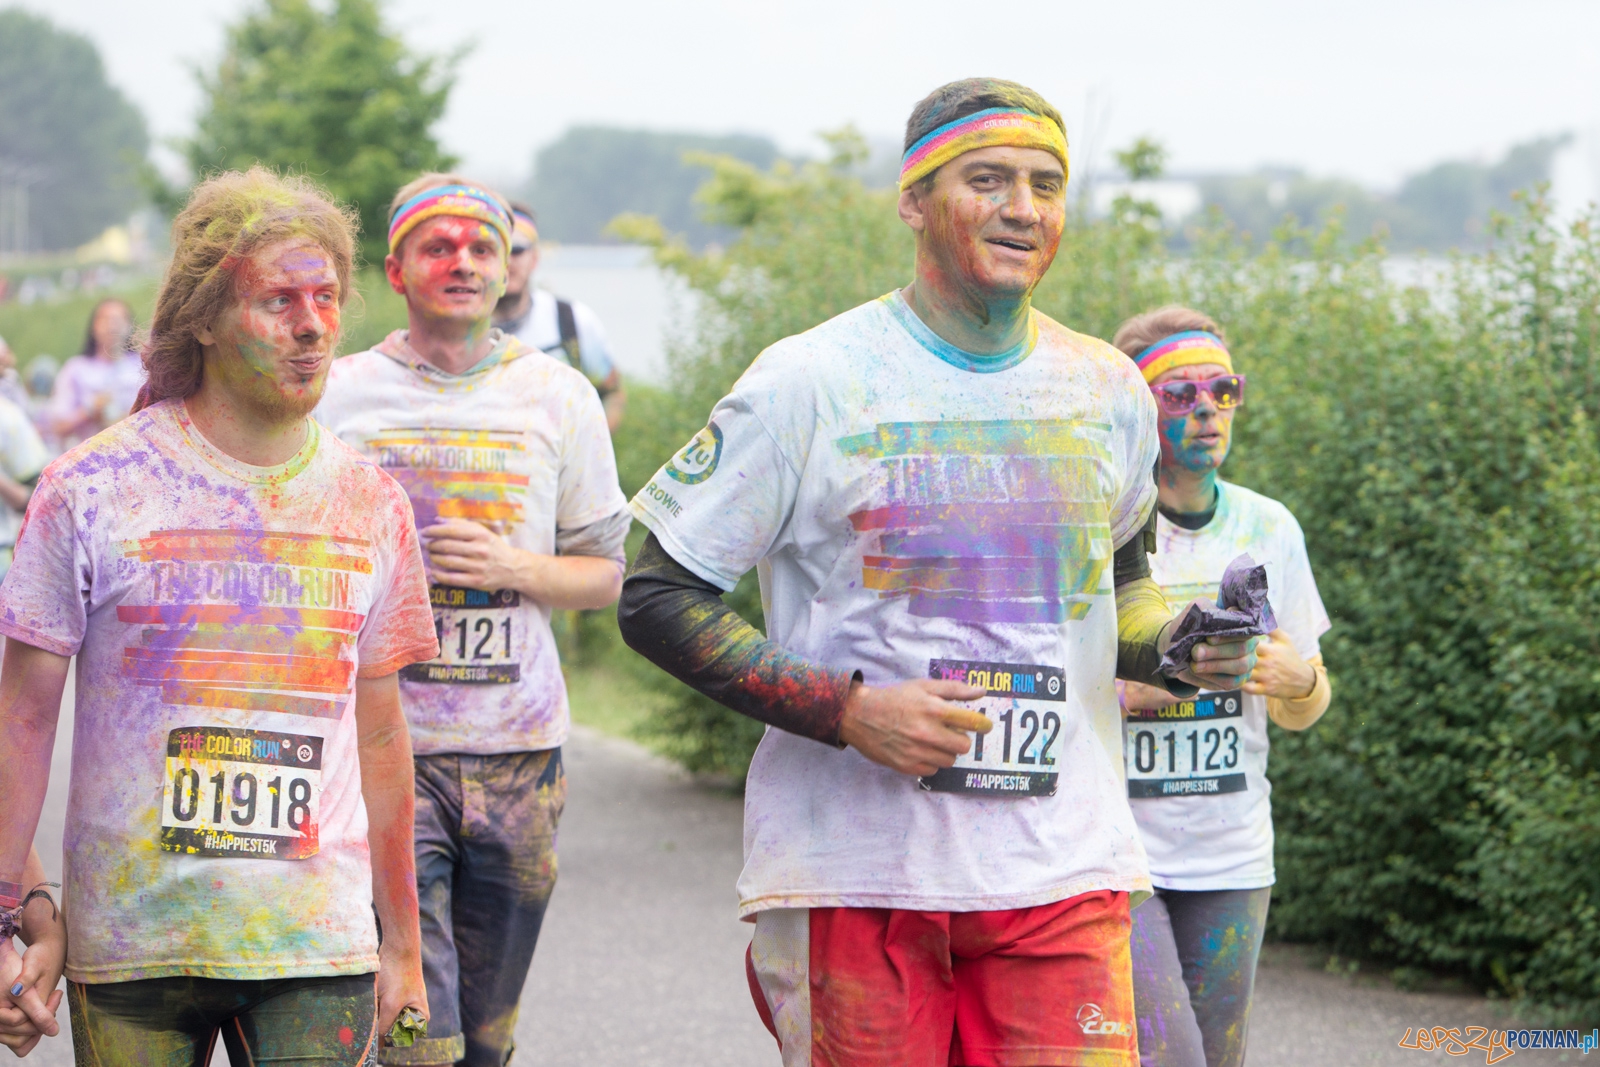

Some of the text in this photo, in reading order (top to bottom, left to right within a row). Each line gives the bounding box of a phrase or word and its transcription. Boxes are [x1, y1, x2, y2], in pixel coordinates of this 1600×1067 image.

[984, 118, 1010, 129] COLOR
[410, 446, 468, 470] COLOR
[470, 448, 506, 472] RUN
[153, 562, 350, 609] THE COLOR RUN
[466, 590, 489, 606] RUN
[968, 669, 1011, 692] COLOR
[1013, 673, 1036, 694] RUN
[1195, 700, 1216, 716] RUN
[179, 734, 280, 759] THE COLOR RUN
[1135, 726, 1239, 773] 01123
[965, 773, 1031, 791] #HAPPIEST5K
[1163, 779, 1219, 793] #HAPPIEST5K
[172, 767, 312, 833] 01918
[204, 835, 277, 854] #HAPPIEST5K
